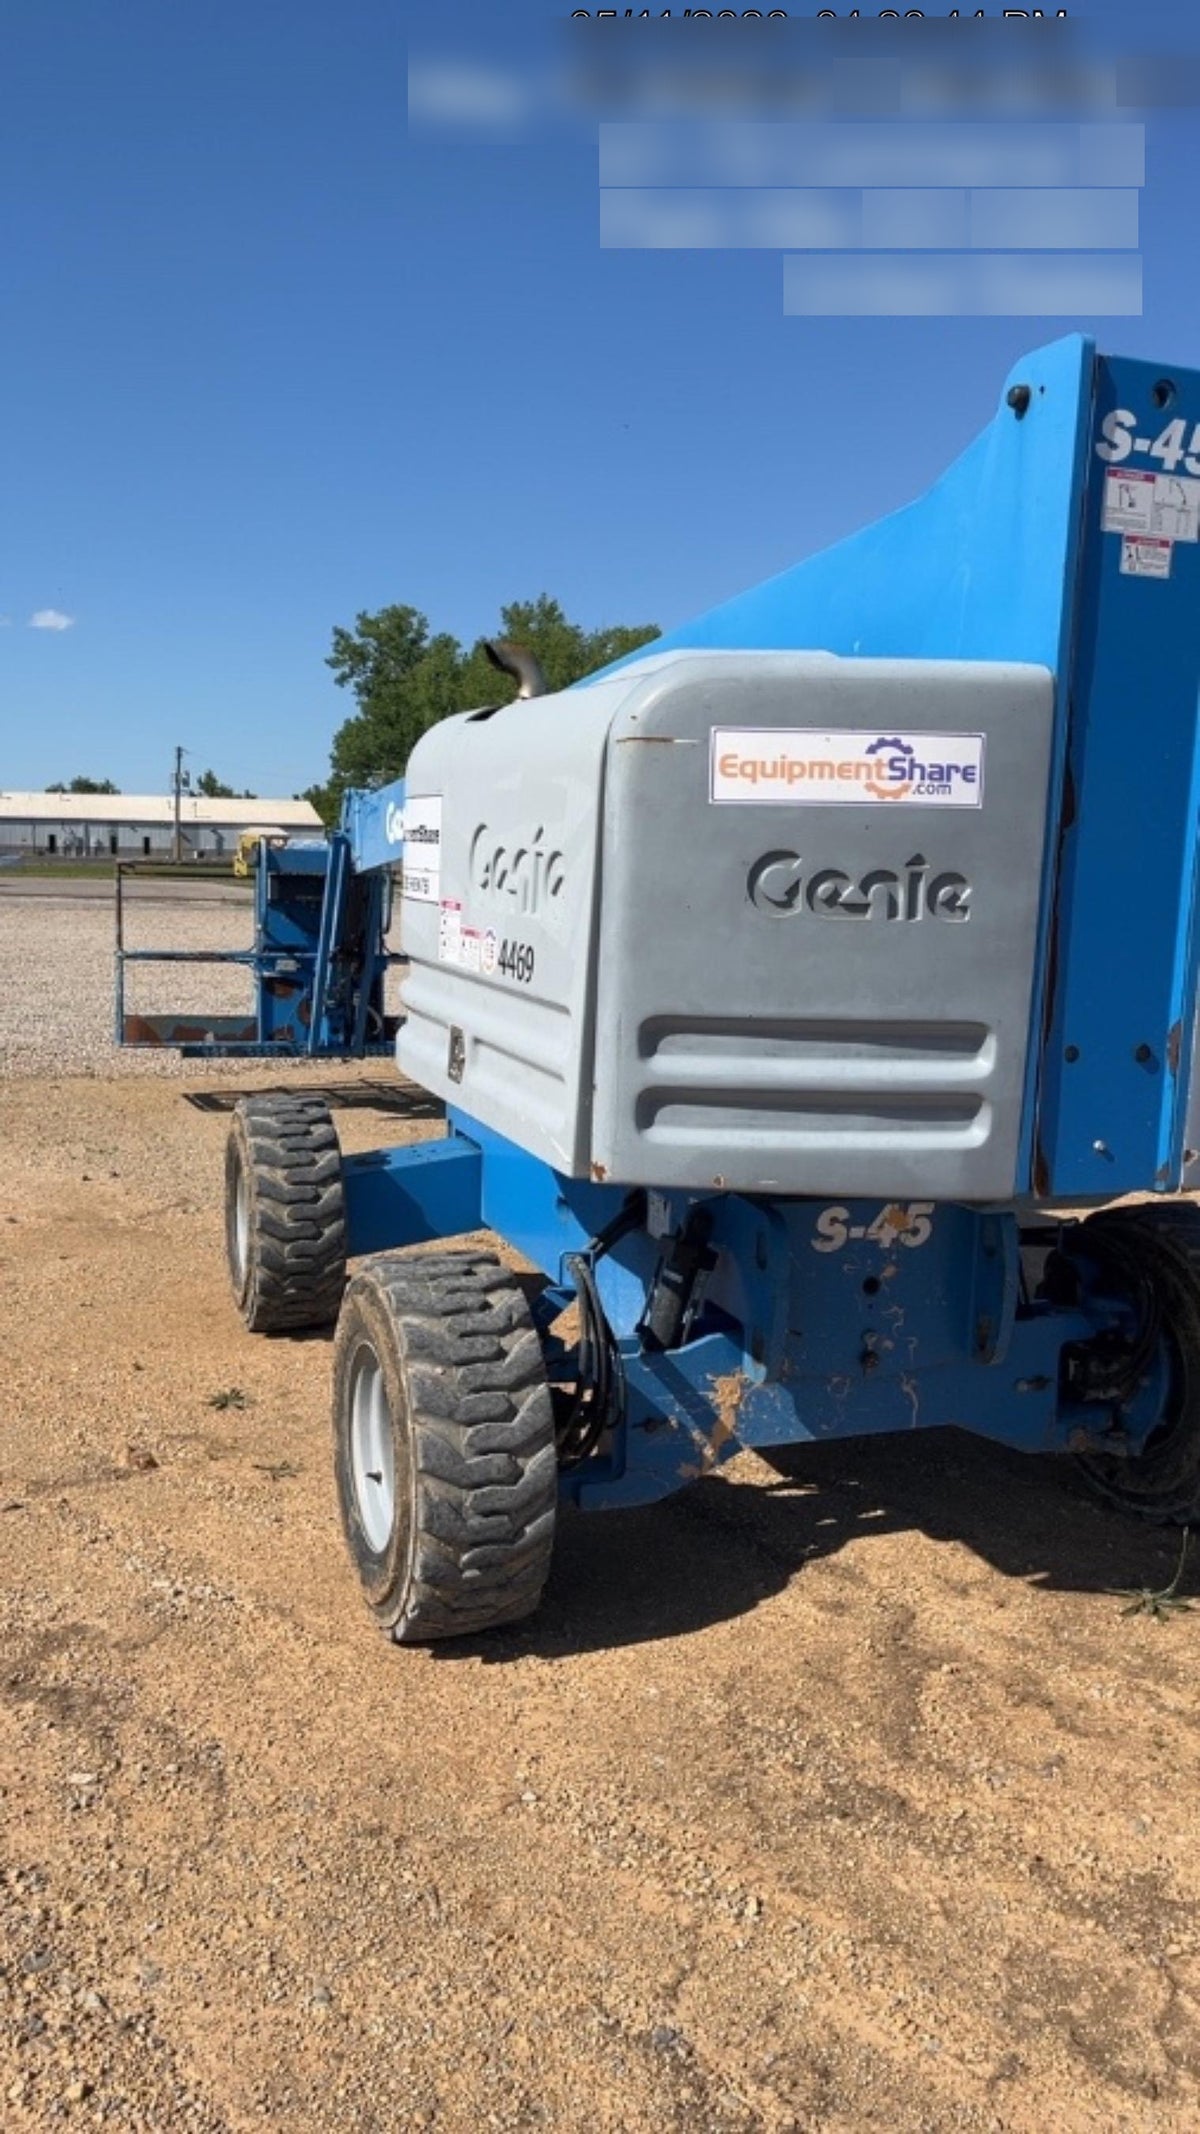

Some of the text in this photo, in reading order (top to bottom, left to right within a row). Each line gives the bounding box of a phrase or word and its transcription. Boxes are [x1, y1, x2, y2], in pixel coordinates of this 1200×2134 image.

[719, 753, 976, 784] EquipmentShare
[747, 850, 973, 923] Genie
[498, 938, 535, 983] 4469
[810, 1201, 936, 1253] S-45
